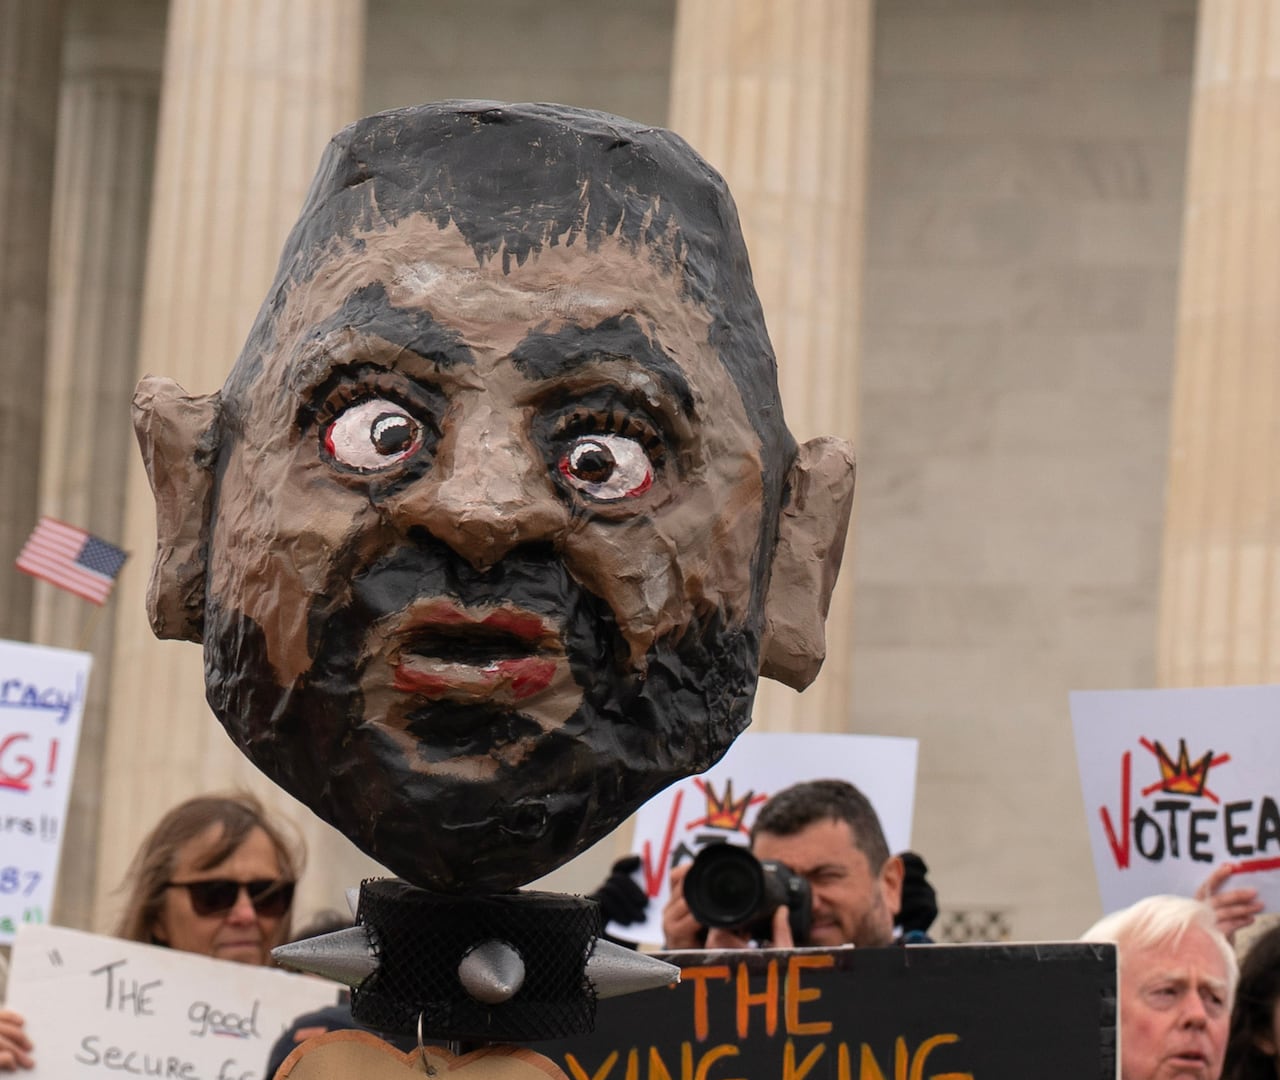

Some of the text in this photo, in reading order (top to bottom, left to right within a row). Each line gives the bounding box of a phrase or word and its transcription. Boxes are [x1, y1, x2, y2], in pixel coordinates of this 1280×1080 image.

[1100, 751, 1219, 870] VOTE
[90, 959, 163, 1016] THE
[188, 999, 261, 1038] good
[667, 955, 834, 1041] THE
